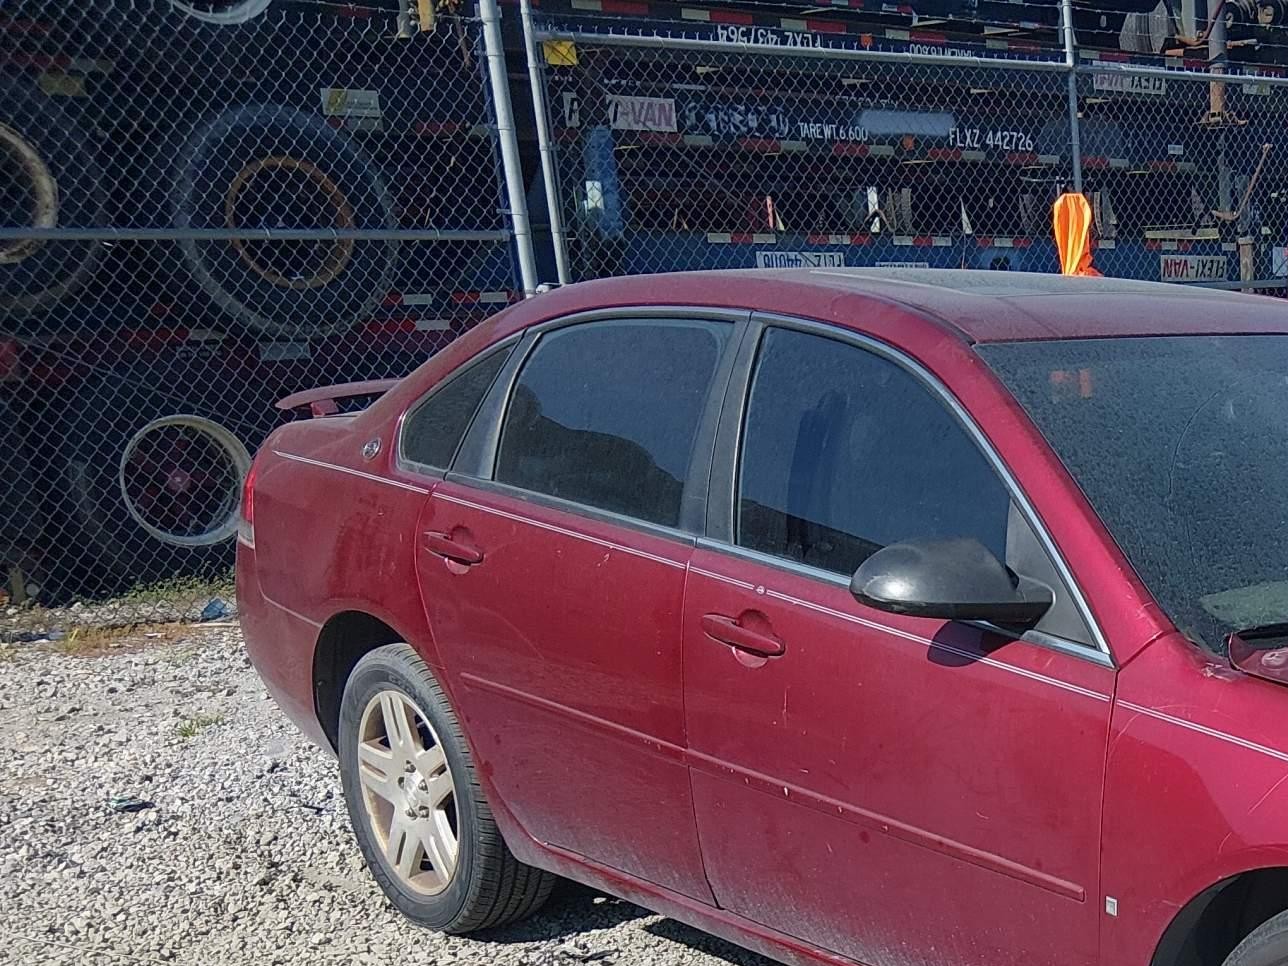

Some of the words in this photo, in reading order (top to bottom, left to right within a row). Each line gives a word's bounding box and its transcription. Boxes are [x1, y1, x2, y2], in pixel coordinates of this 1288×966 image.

[949, 128, 980, 148] FLXZ
[986, 130, 1033, 151] 442726
[1163, 259, 1226, 279] FLEXI-VAN
